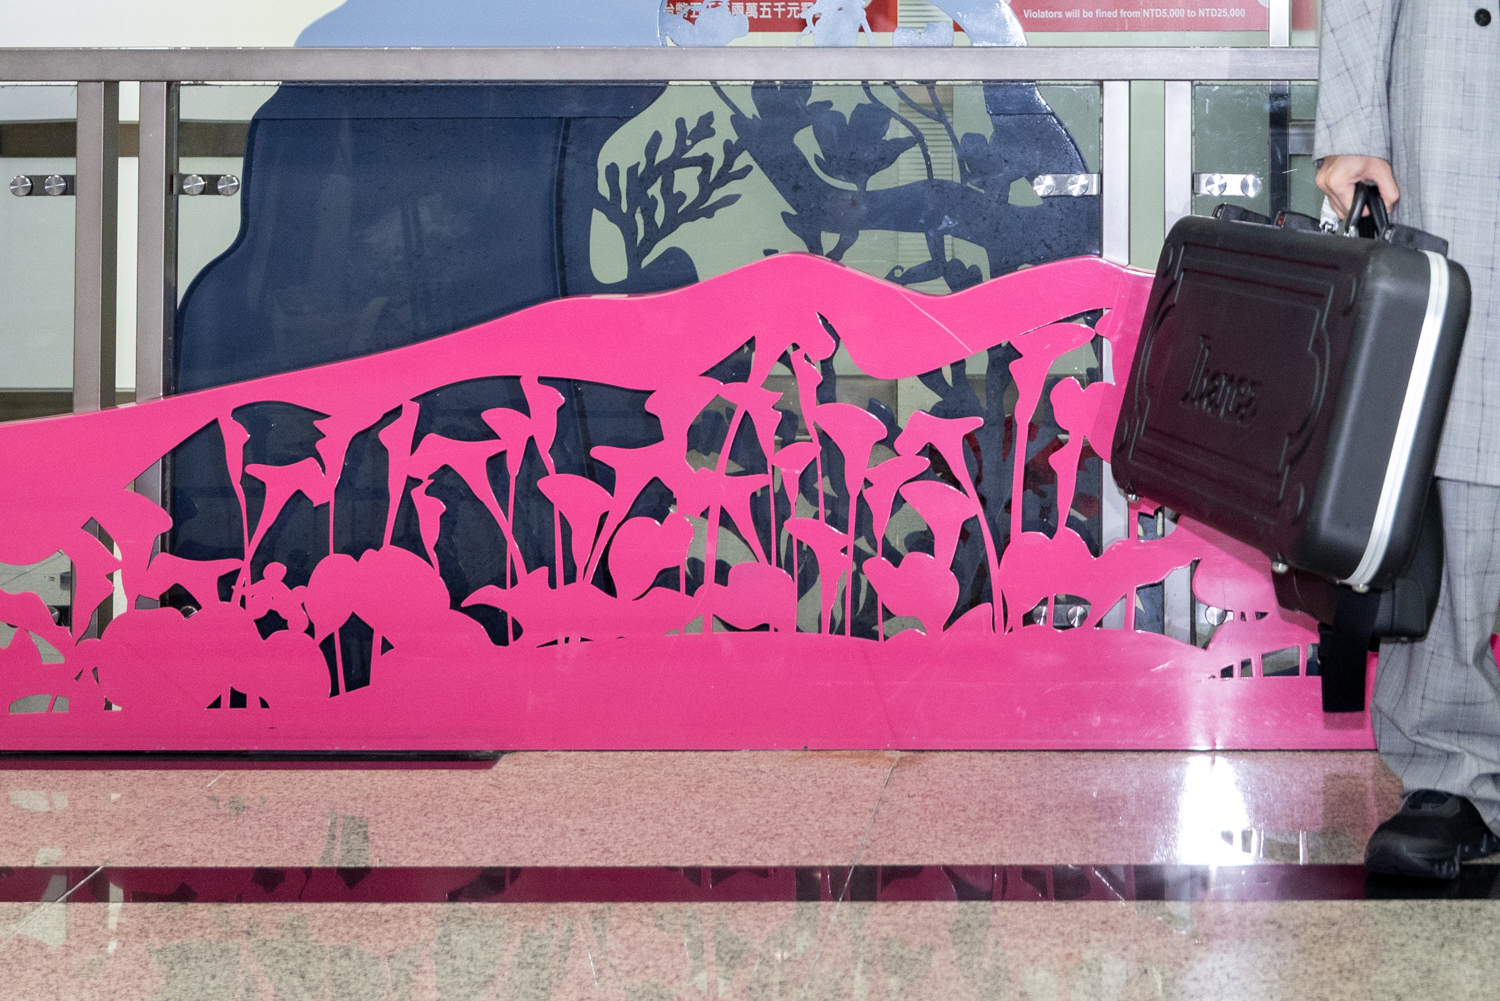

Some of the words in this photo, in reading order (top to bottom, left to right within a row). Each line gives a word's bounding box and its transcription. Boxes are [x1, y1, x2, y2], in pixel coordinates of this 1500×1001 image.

[1023, 8, 1063, 19] Violators
[1065, 8, 1080, 19] will
[1082, 8, 1093, 18] be
[1096, 8, 1117, 18] fined
[1120, 8, 1140, 18] from
[1143, 8, 1185, 20] NTD5,000
[1187, 8, 1196, 18] to
[1199, 8, 1245, 19] NTD25,000
